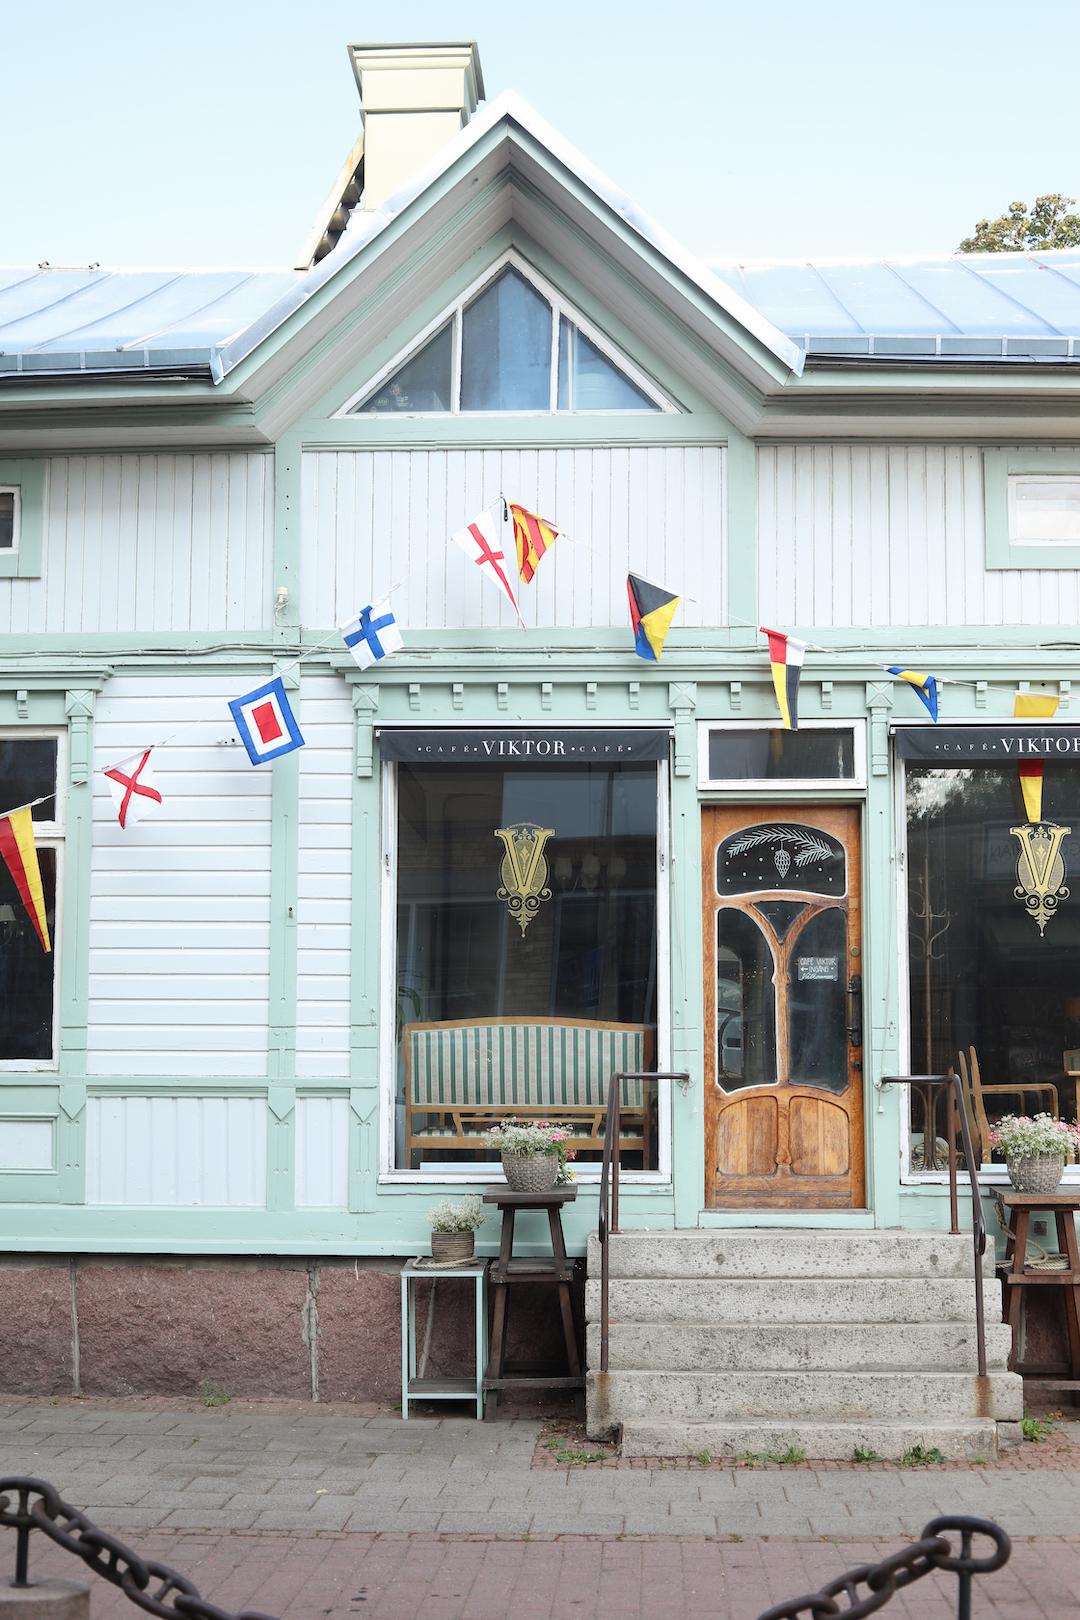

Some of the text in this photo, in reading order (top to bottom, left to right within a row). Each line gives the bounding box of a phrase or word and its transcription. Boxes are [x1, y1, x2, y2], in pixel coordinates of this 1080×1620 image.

[425, 740, 624, 755] CAFÉ VIKTOR CAFÉ
